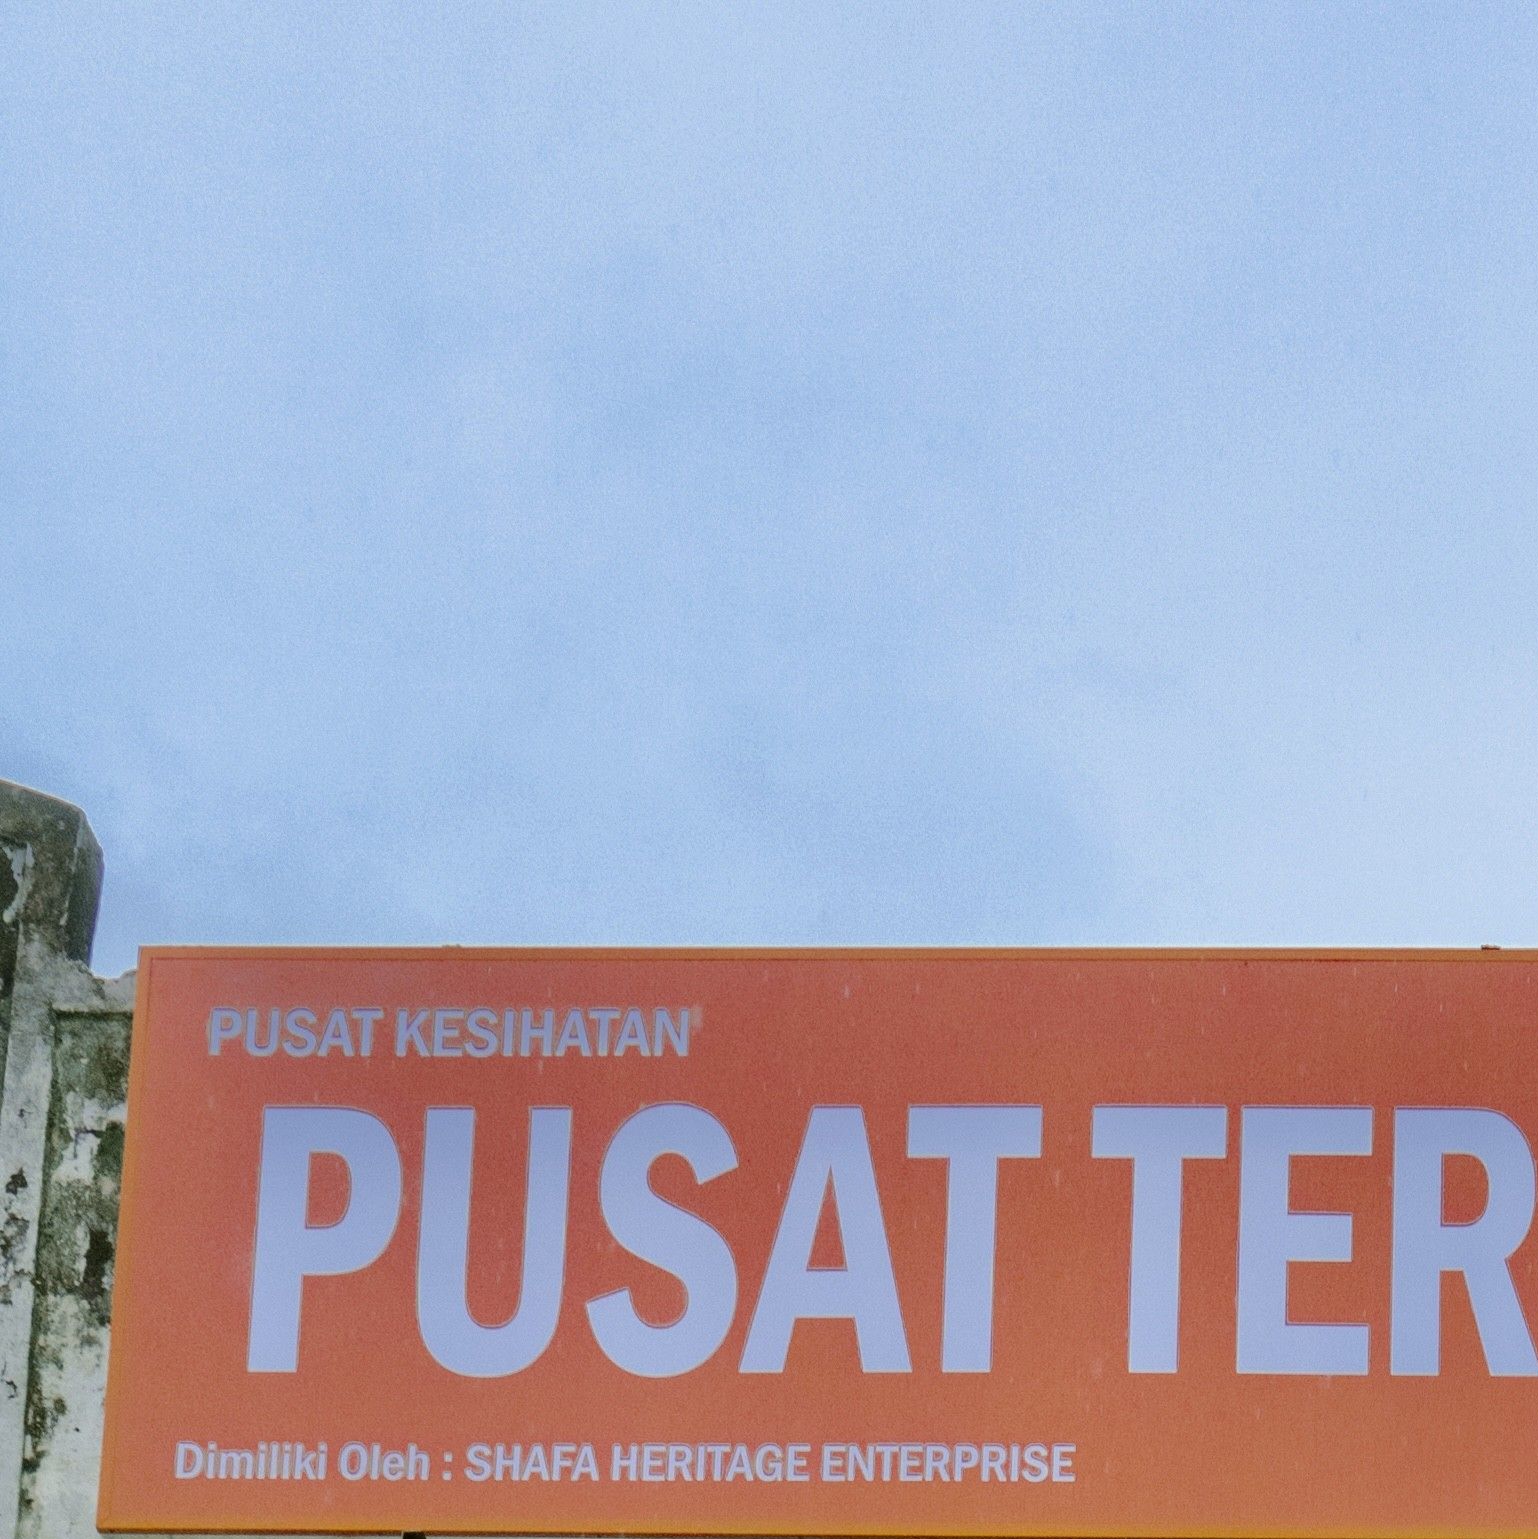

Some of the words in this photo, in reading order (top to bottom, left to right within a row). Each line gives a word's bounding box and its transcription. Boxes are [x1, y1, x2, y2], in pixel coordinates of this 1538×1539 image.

[207, 1007, 384, 1057] PUSAT
[395, 1007, 690, 1058] KESIHATAN
[246, 1100, 1042, 1378] PUSAT
[174, 1440, 328, 1481] Dimiliki
[338, 1441, 431, 1482] Oleh
[464, 1442, 600, 1482] SHAFA
[610, 1442, 811, 1483] HERITAGE
[821, 1443, 1077, 1484] ENTERPRISE
